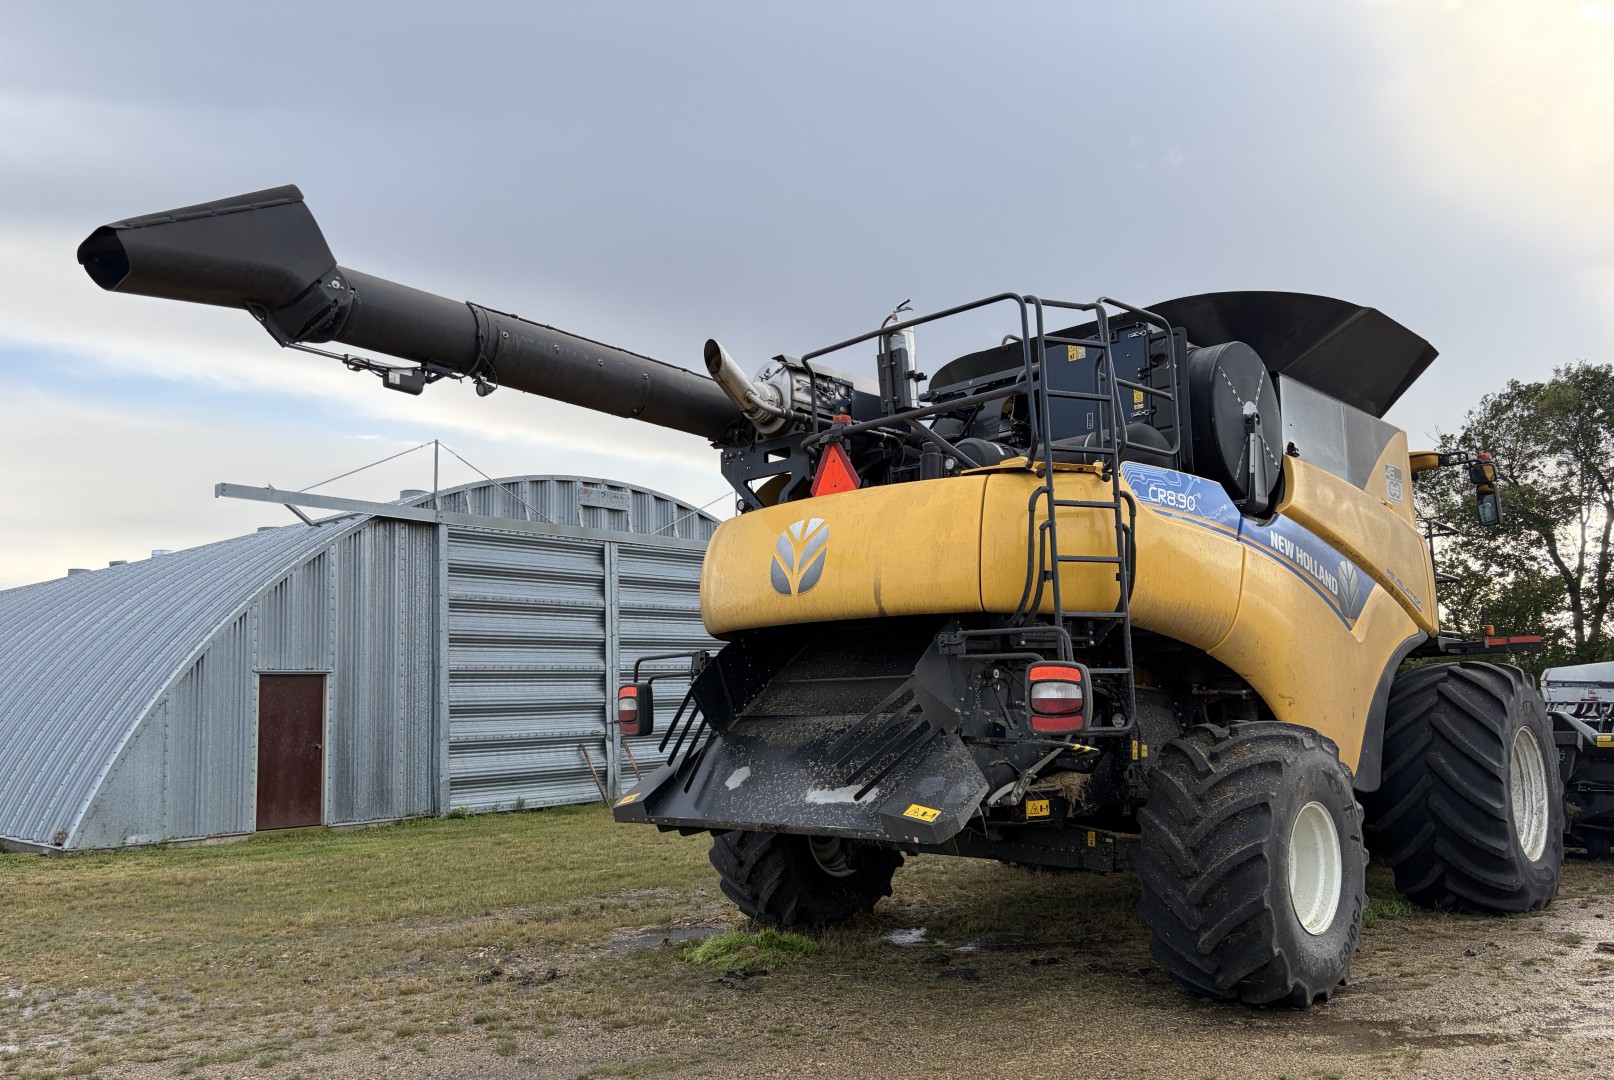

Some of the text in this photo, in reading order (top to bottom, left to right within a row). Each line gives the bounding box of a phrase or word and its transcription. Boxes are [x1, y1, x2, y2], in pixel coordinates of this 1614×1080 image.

[1149, 486, 1196, 511] CR8.90
[1270, 530, 1339, 596] NEW HOLLAND
